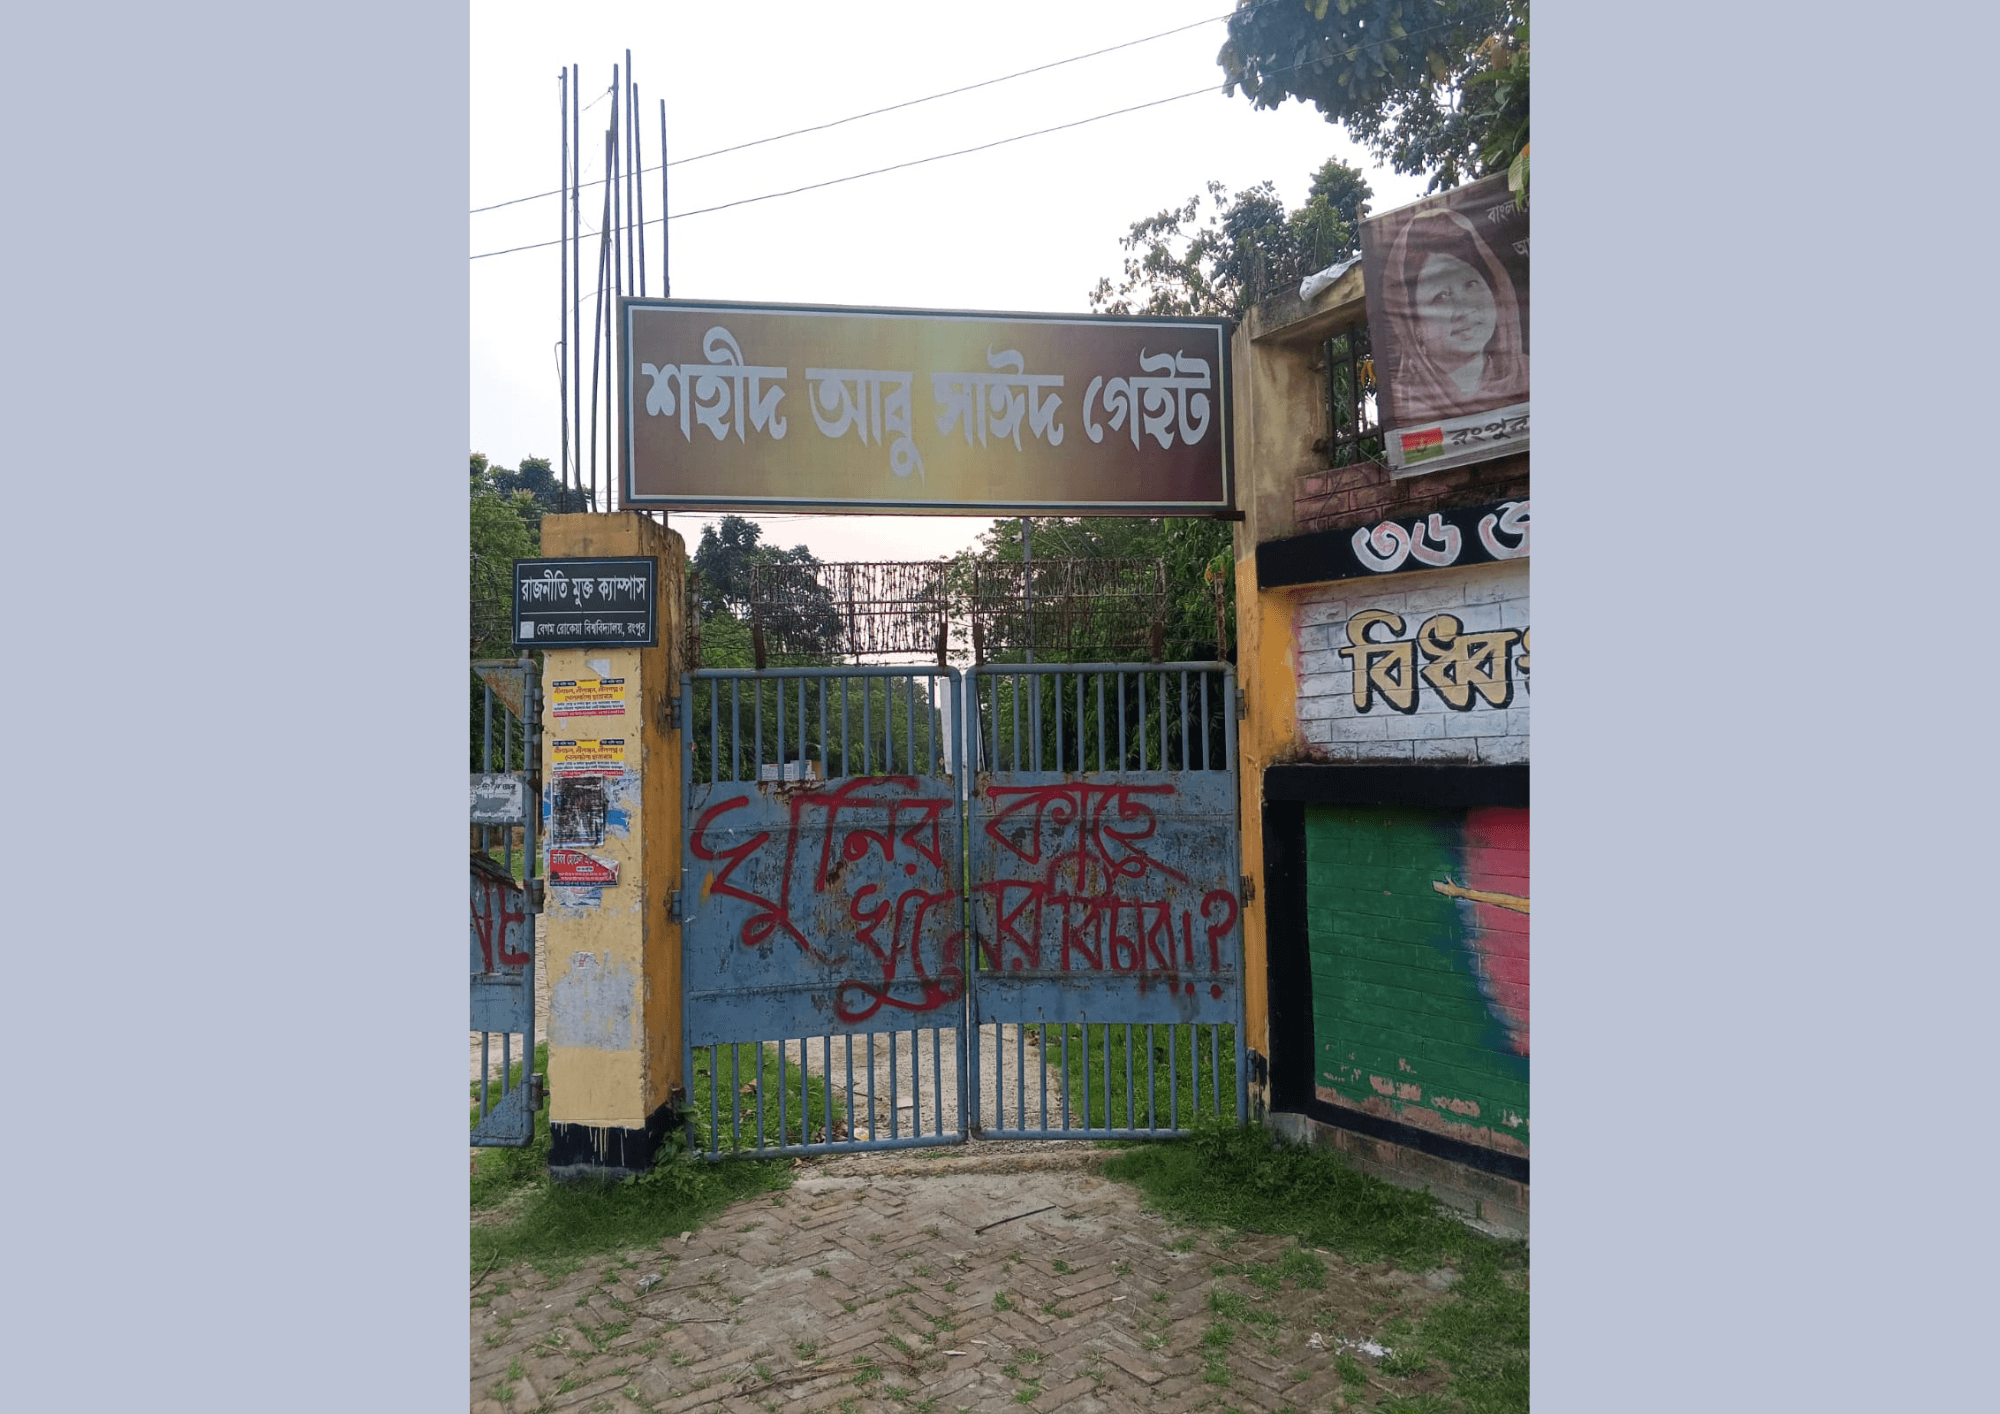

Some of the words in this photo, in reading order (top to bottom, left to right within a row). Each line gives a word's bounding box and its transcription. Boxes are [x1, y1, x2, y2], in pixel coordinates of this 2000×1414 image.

[641, 325, 787, 444] শহীদ
[805, 367, 926, 486] আবু
[931, 343, 1064, 452] সাঈদ
[1083, 347, 1212, 452] গেইট
[1352, 513, 1462, 573] ৩৬
[520, 569, 570, 602] রাজনীতি
[571, 577, 595, 608] মুক্ত
[597, 574, 647, 602] ক্যাম্পাস
[537, 622, 555, 636] বেগম
[557, 621, 582, 636] রোকেয়া
[627, 621, 646, 637] রংপুর
[690, 776, 953, 964] খুনির
[985, 782, 1188, 892] কাছে
